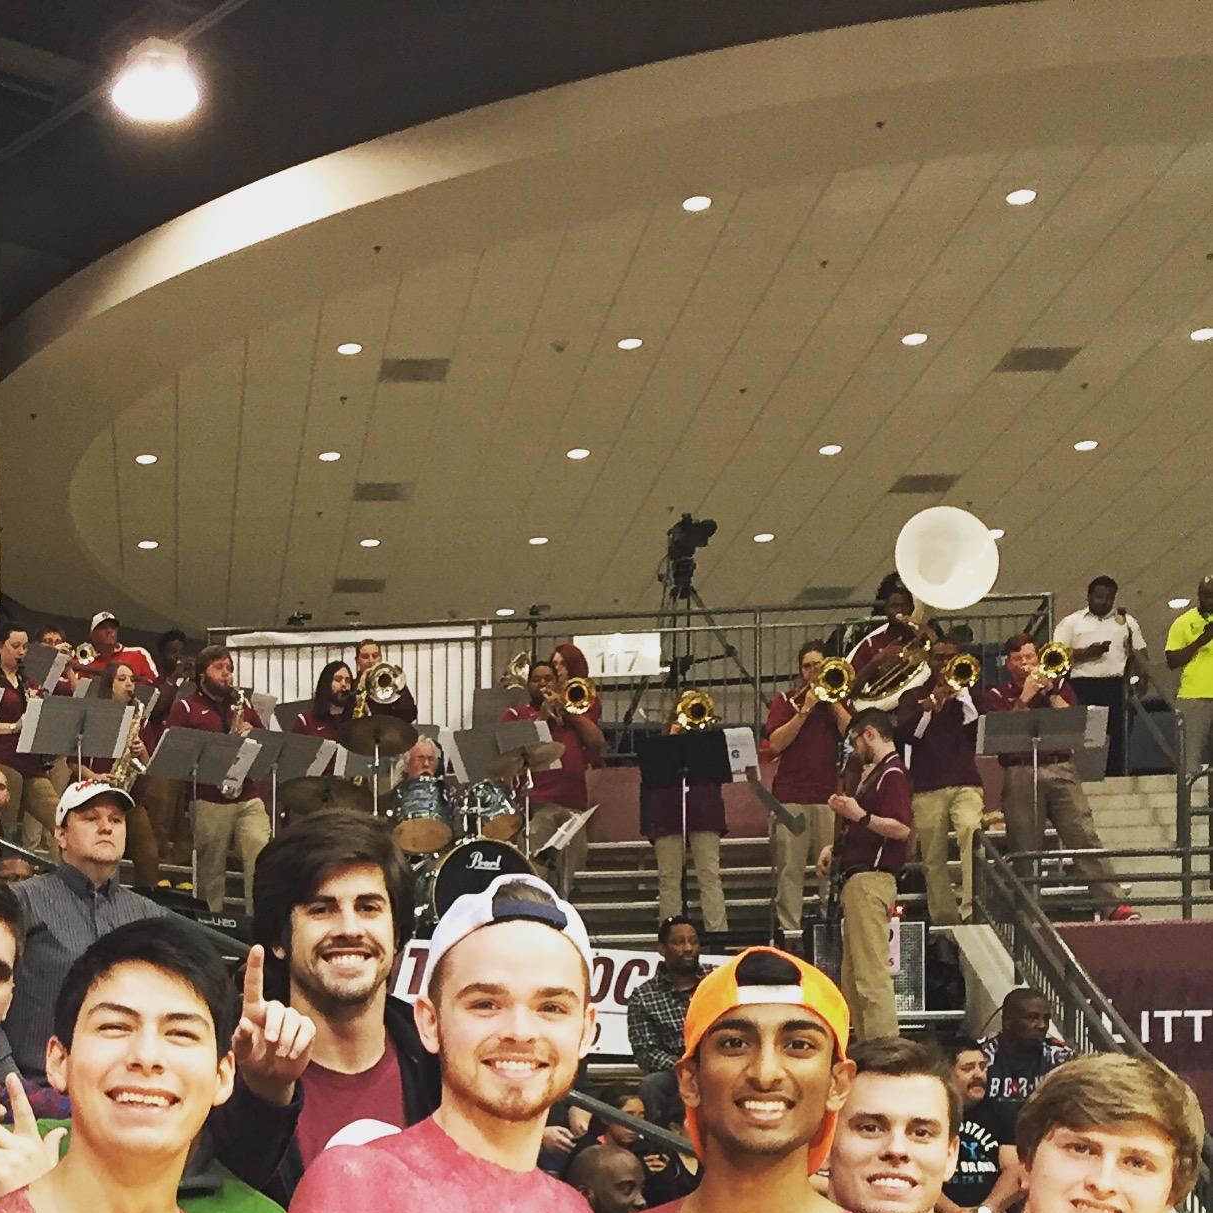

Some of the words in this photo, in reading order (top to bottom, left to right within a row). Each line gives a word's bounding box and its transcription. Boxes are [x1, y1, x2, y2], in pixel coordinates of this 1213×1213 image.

[589, 636, 646, 649] SECION
[596, 650, 639, 674] 117
[466, 851, 502, 870] Pearl
